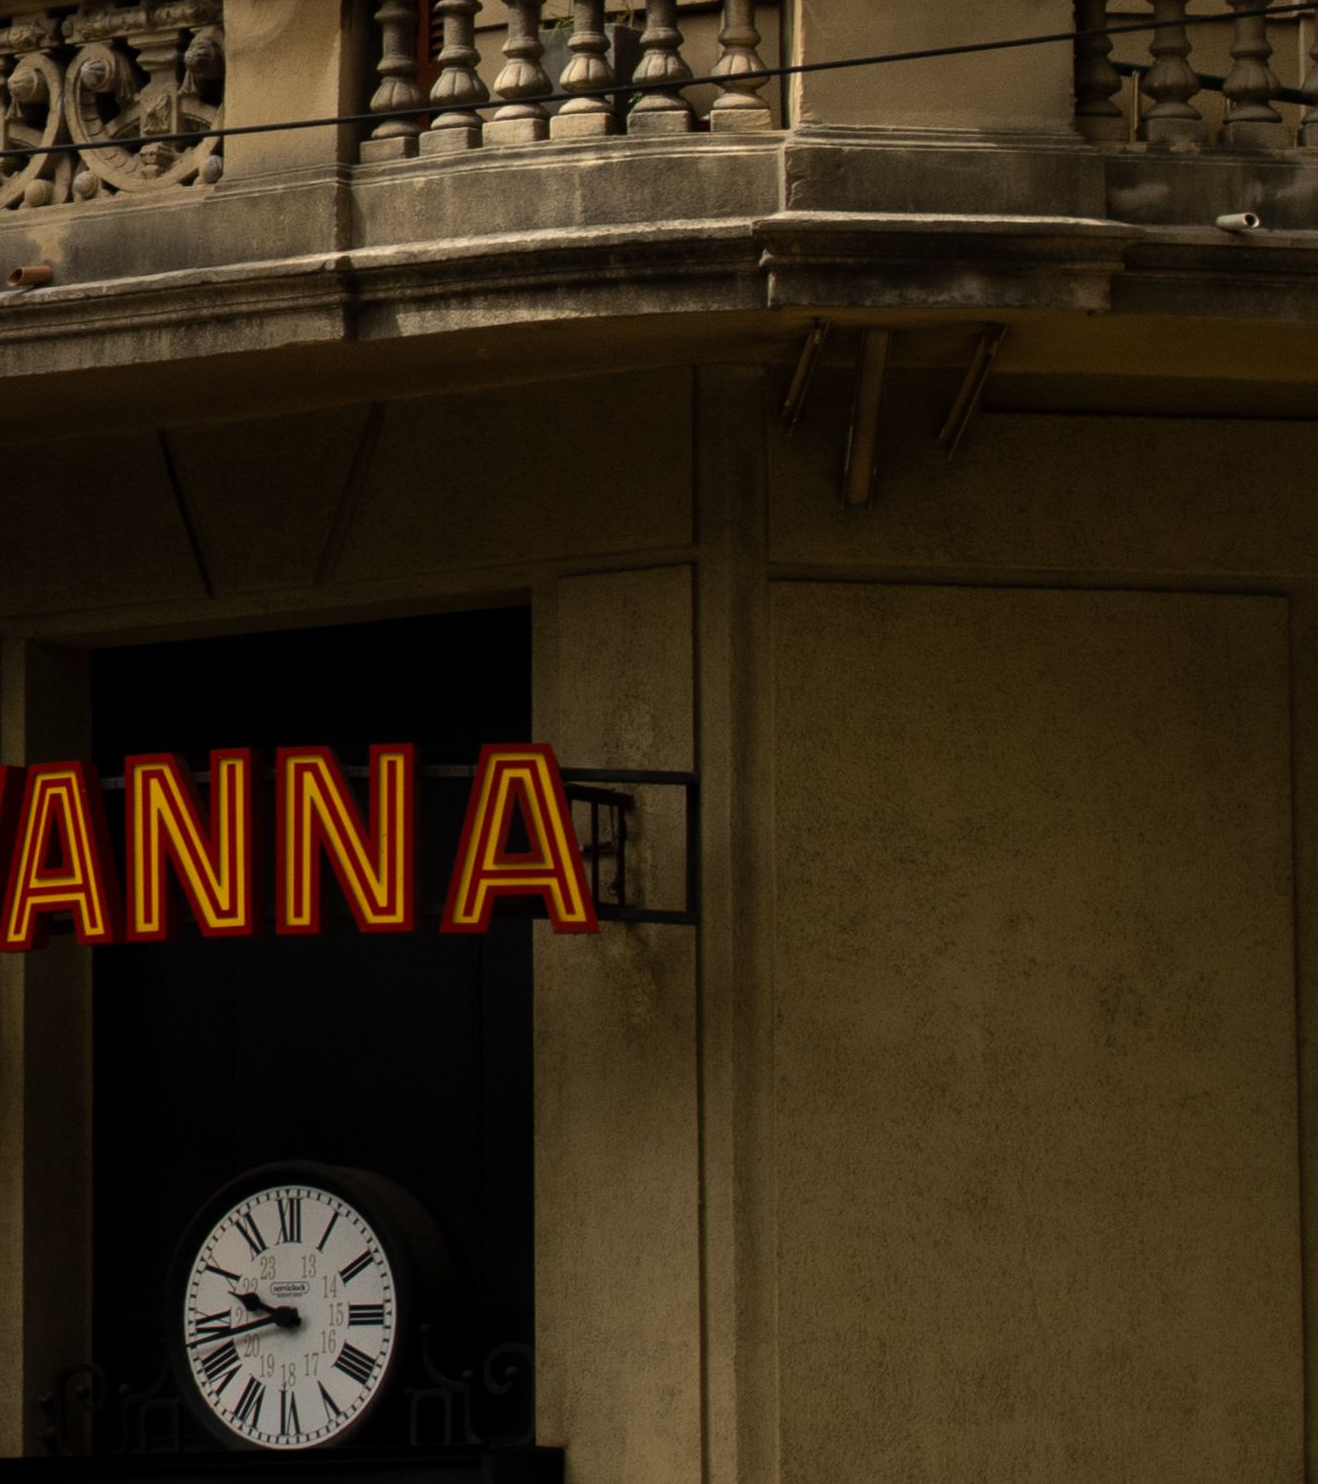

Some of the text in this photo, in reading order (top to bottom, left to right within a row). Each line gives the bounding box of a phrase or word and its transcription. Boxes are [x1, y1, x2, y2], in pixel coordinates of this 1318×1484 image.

[276, 1198, 302, 1245] XII
[260, 1256, 276, 1280] 23
[301, 1254, 317, 1279] 13
[338, 1249, 374, 1286] II
[323, 1275, 338, 1299] 14
[329, 1302, 344, 1327] 15
[348, 1304, 384, 1326] III
[244, 1334, 260, 1358] 20
[321, 1330, 336, 1354] 16
[260, 1354, 275, 1378] 19
[281, 1363, 297, 1387] 18
[304, 1352, 319, 1377] 17
